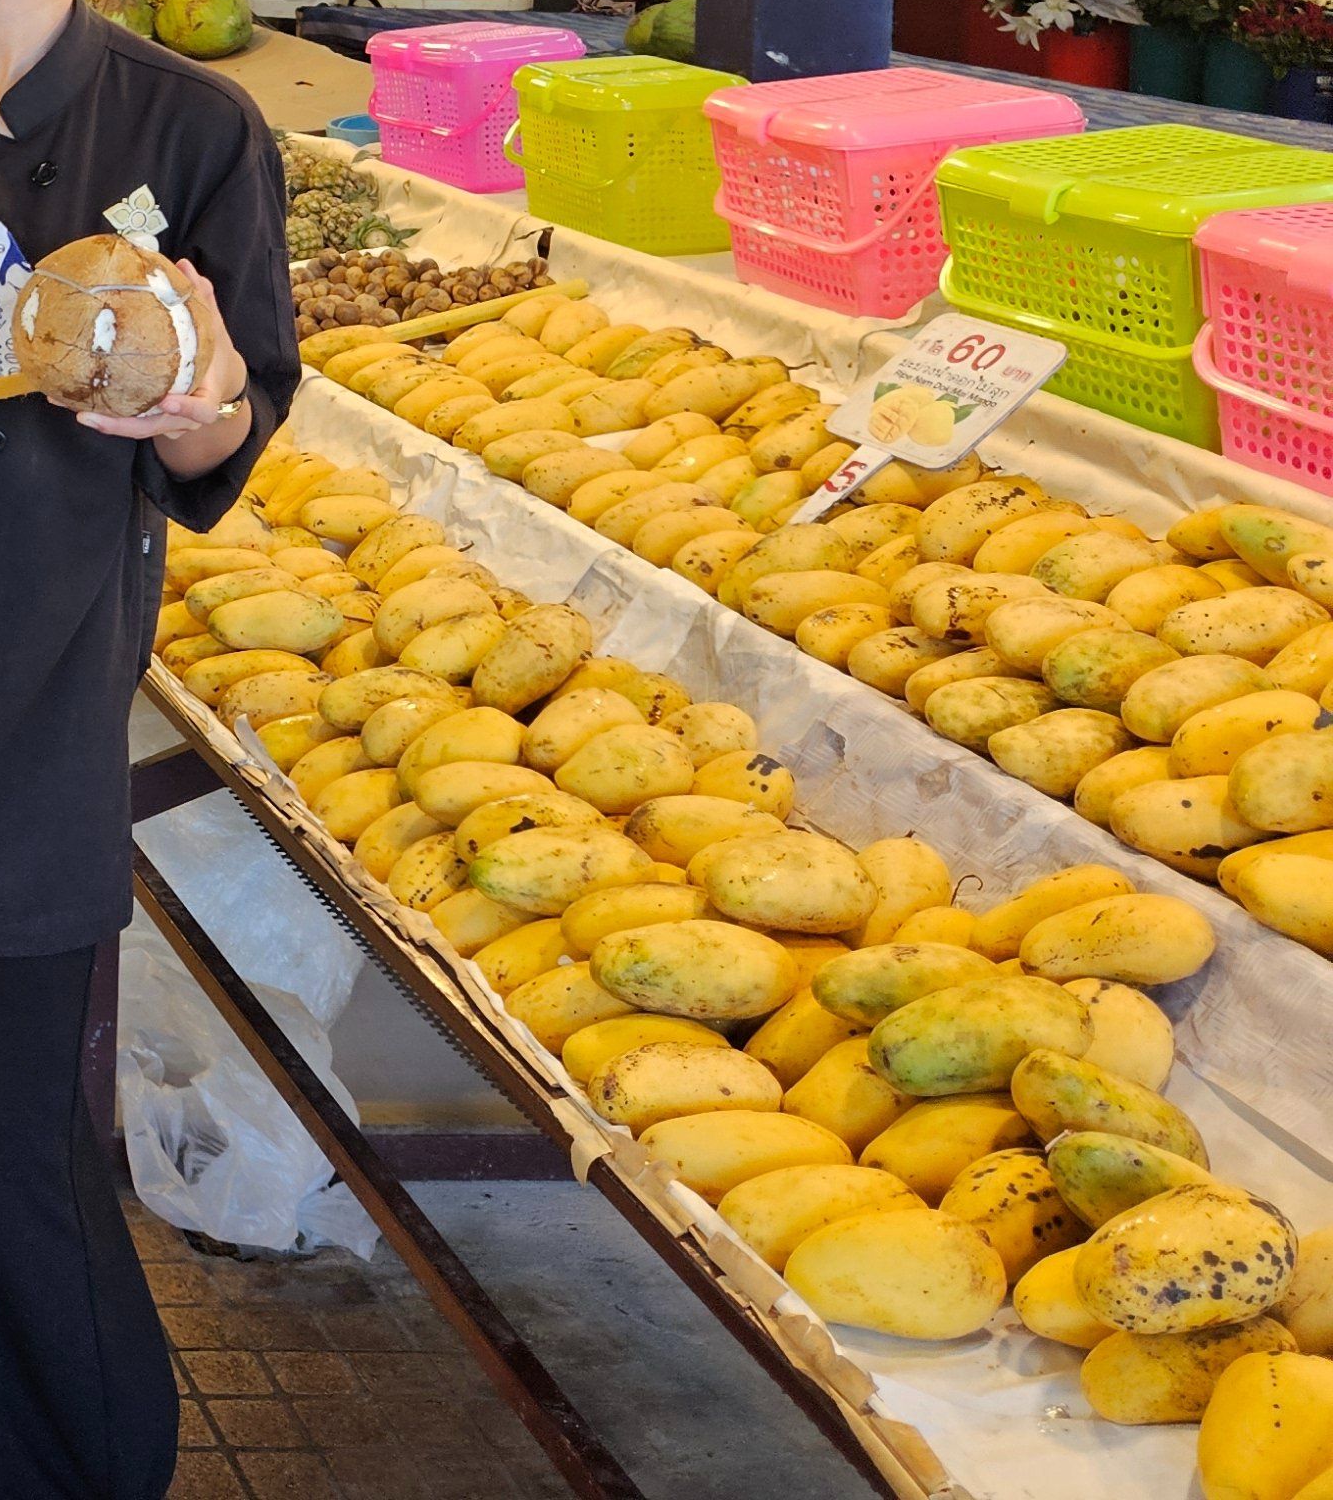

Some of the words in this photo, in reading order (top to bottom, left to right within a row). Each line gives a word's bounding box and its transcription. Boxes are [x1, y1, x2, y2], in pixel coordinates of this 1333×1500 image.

[946, 334, 1006, 372] 60
[914, 373, 934, 388] Nam
[932, 380, 951, 394] Dok
[949, 384, 968, 399] Mai
[967, 391, 997, 409] Mango
